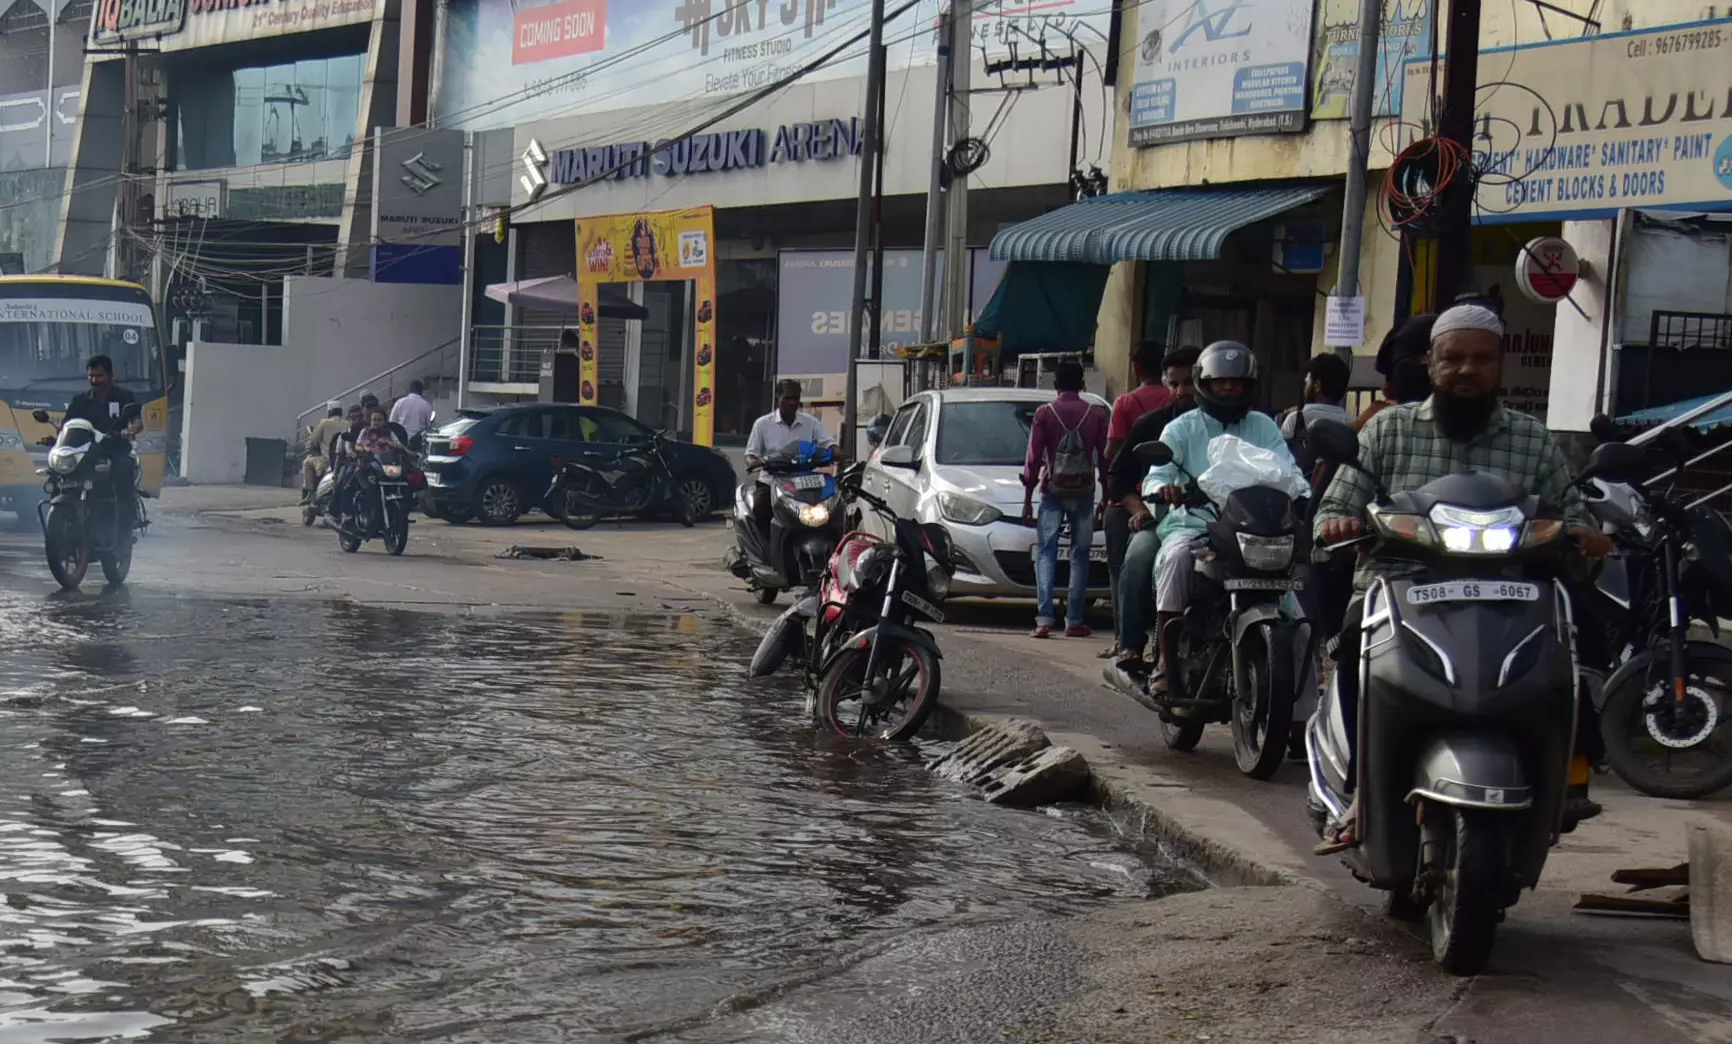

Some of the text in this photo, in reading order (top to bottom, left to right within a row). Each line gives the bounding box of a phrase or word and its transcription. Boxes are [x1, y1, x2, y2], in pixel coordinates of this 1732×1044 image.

[268, 8, 299, 26] Century
[301, 3, 330, 21] Quality
[520, 10, 596, 48] COMING SOON
[724, 38, 792, 65] FITNESS STUDIO
[1627, 40, 1646, 58] Cell
[1168, 50, 1251, 73] INTERIORS
[705, 73, 740, 93] Elevate
[742, 69, 766, 88] Your
[551, 141, 649, 187] MARUTI
[653, 127, 763, 177] SUZUKI
[1672, 132, 1713, 161] PAINT
[1505, 169, 1665, 205] CEMENT BLOCKS & DOORS
[97, 311, 146, 323] SCHOOL
[124, 331, 138, 342] 04
[1463, 584, 1480, 598] GS
